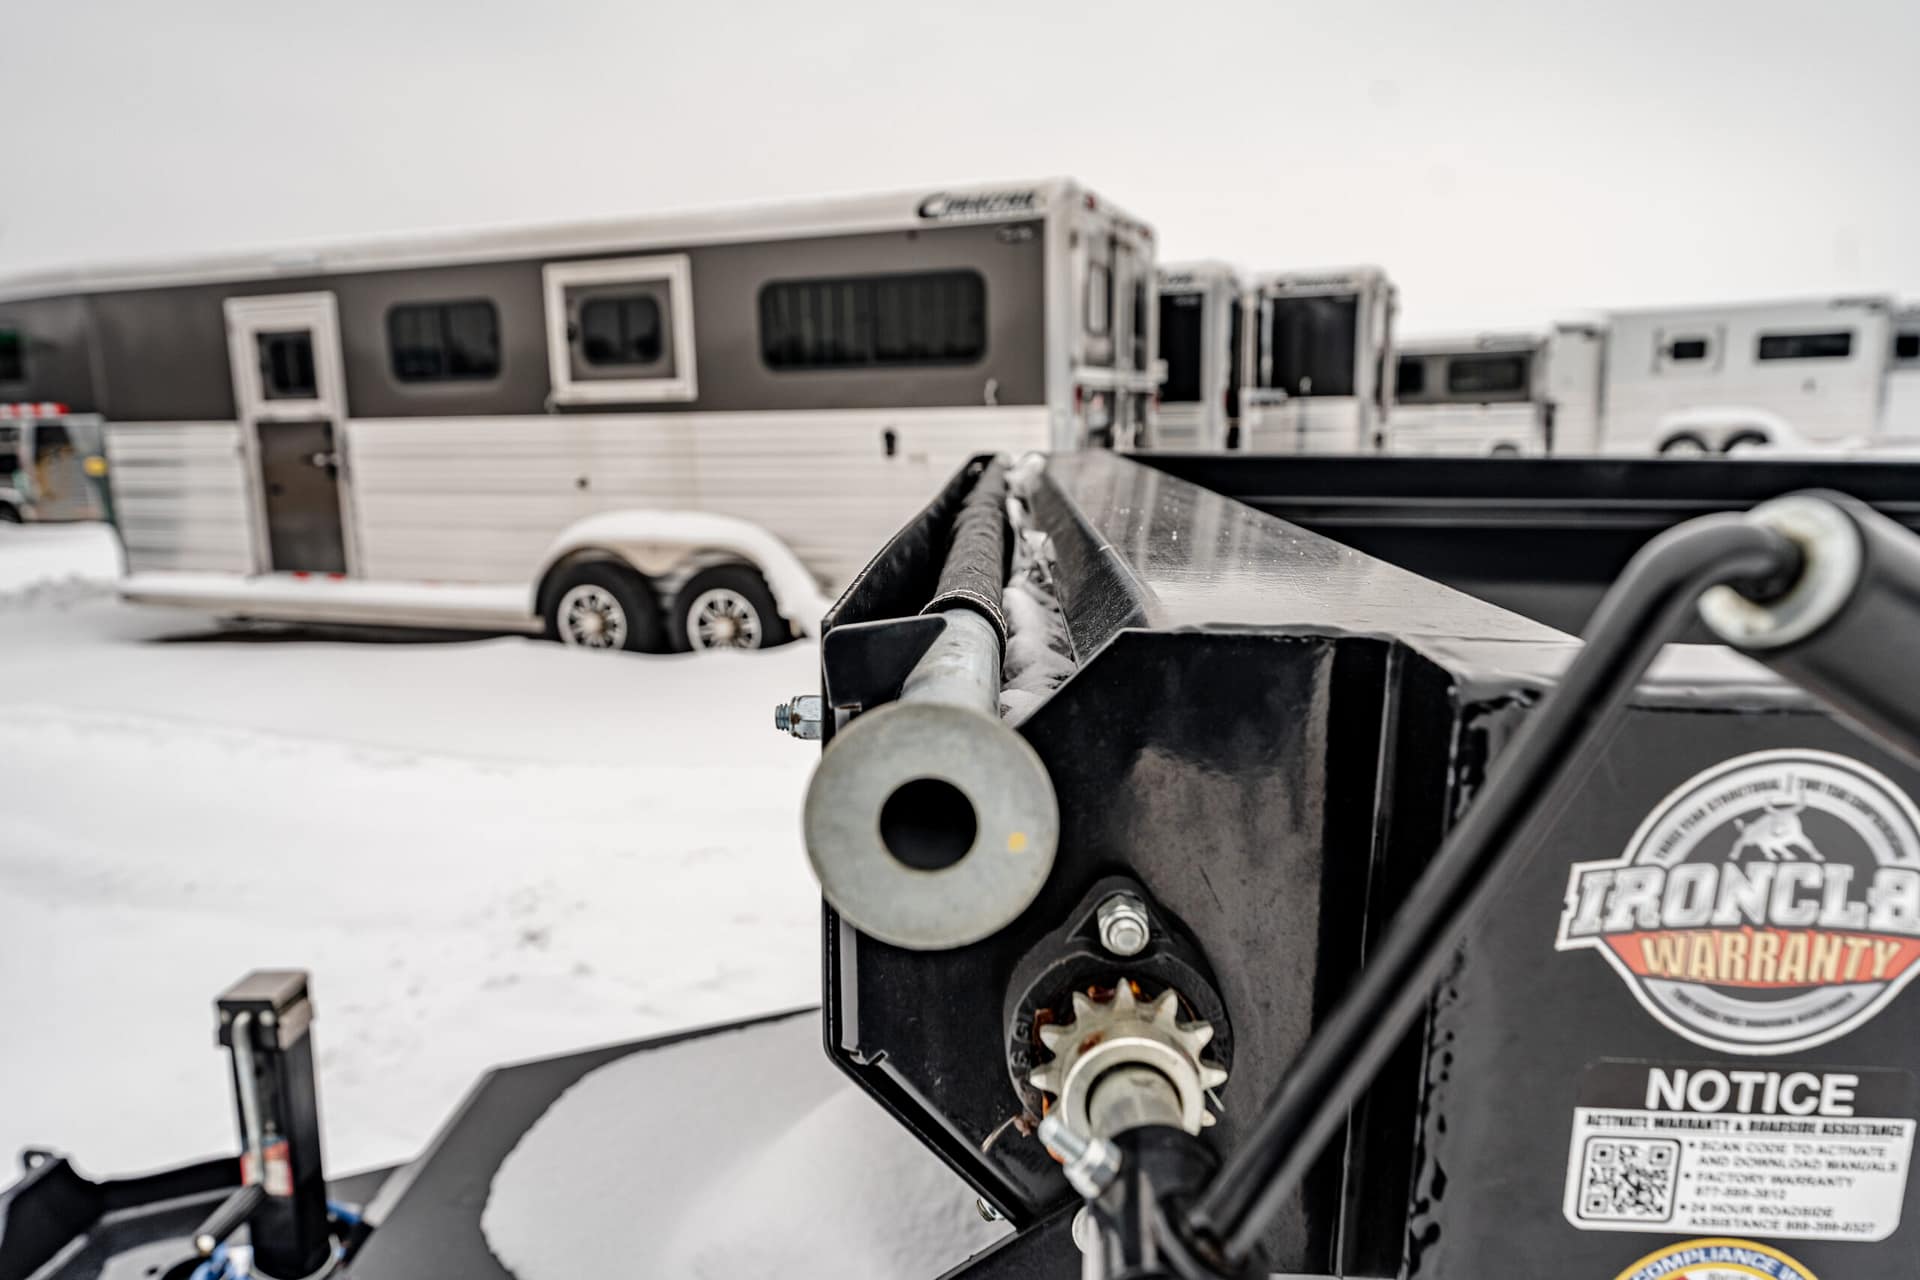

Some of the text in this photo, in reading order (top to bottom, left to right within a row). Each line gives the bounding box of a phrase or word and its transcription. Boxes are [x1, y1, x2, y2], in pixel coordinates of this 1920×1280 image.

[1640, 931, 1902, 984] WARRANTY
[1645, 1067, 1859, 1117] NOTICE
[1653, 1116, 1730, 1131] WARRANTY
[1749, 1120, 1816, 1134] ROADSIDE
[1821, 1122, 1905, 1137] ASSISTANCE
[1700, 1140, 1742, 1152] SCAN
[1698, 1155, 1729, 1167] AND
[1770, 1174, 1856, 1188] WARRANTY
